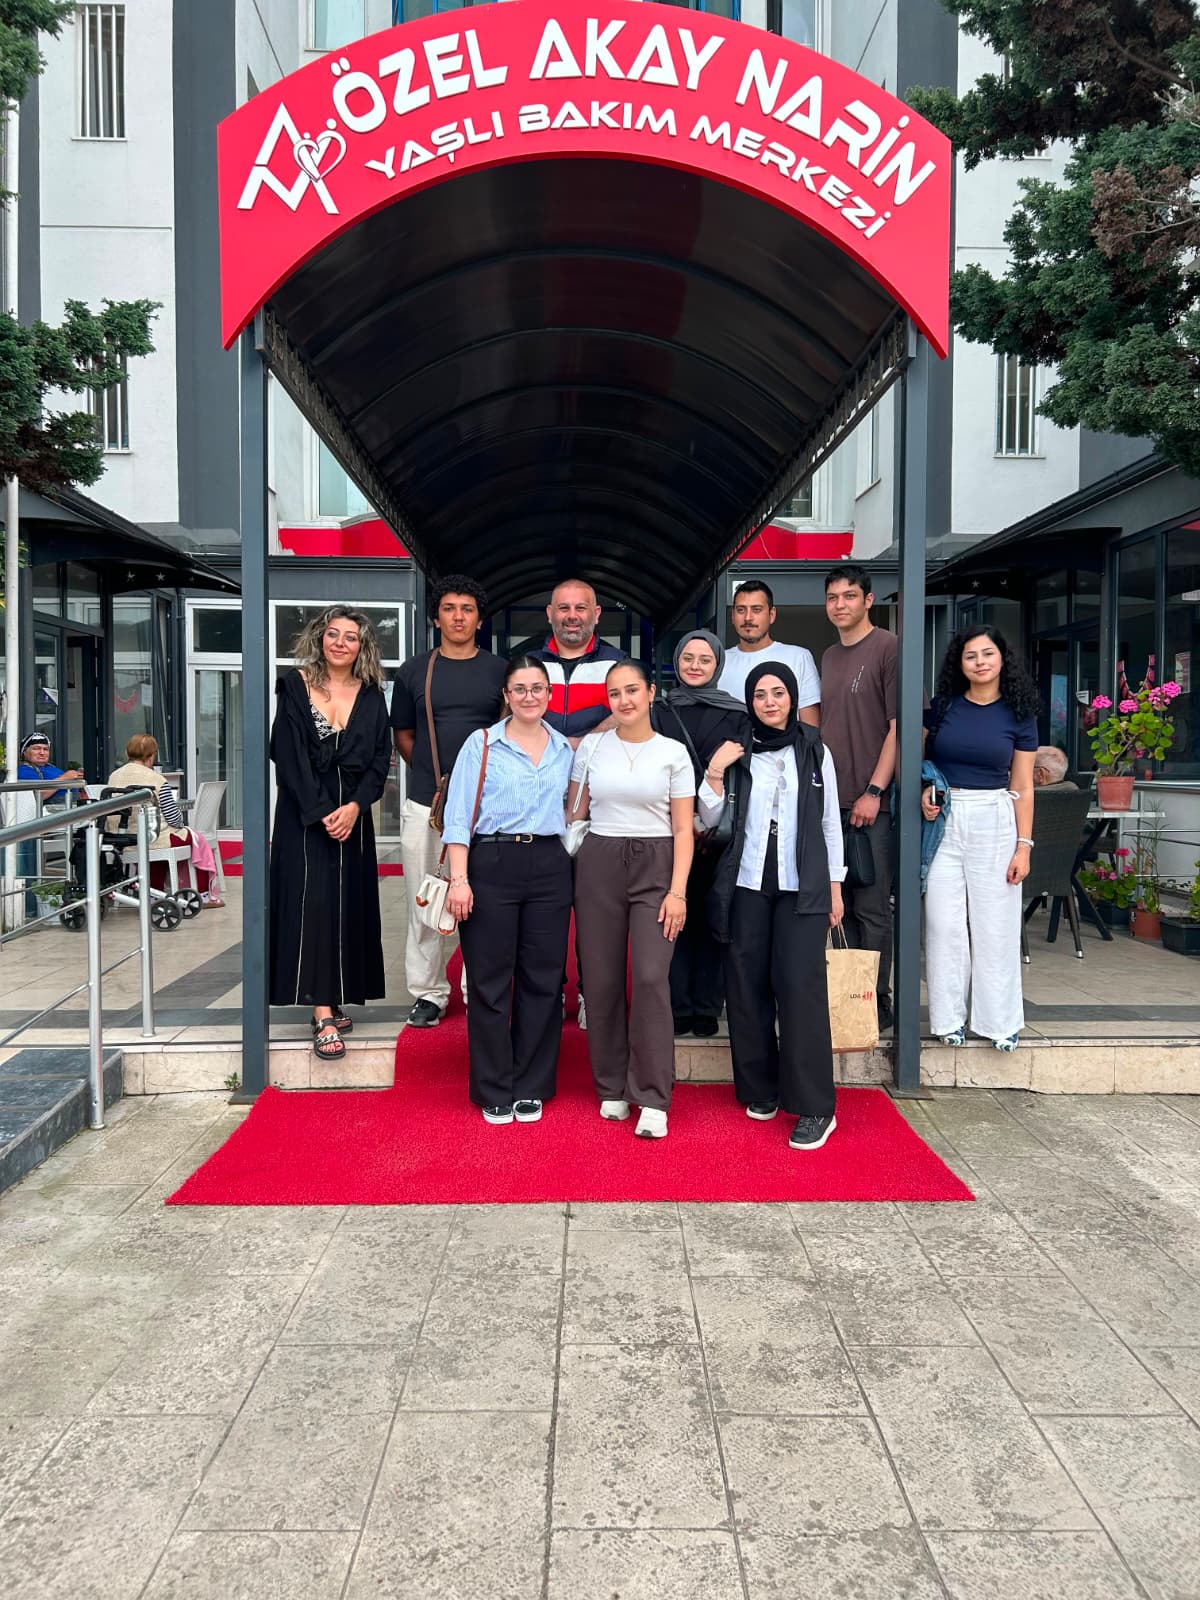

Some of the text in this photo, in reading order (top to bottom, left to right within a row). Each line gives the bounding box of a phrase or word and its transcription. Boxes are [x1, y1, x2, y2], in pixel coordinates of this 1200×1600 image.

[331, 18, 937, 206] ÖZEL AKAY NARİN
[364, 111, 505, 180] YAŞLI
[518, 101, 677, 136] BAKIM
[689, 115, 891, 239] MERKEZİ
